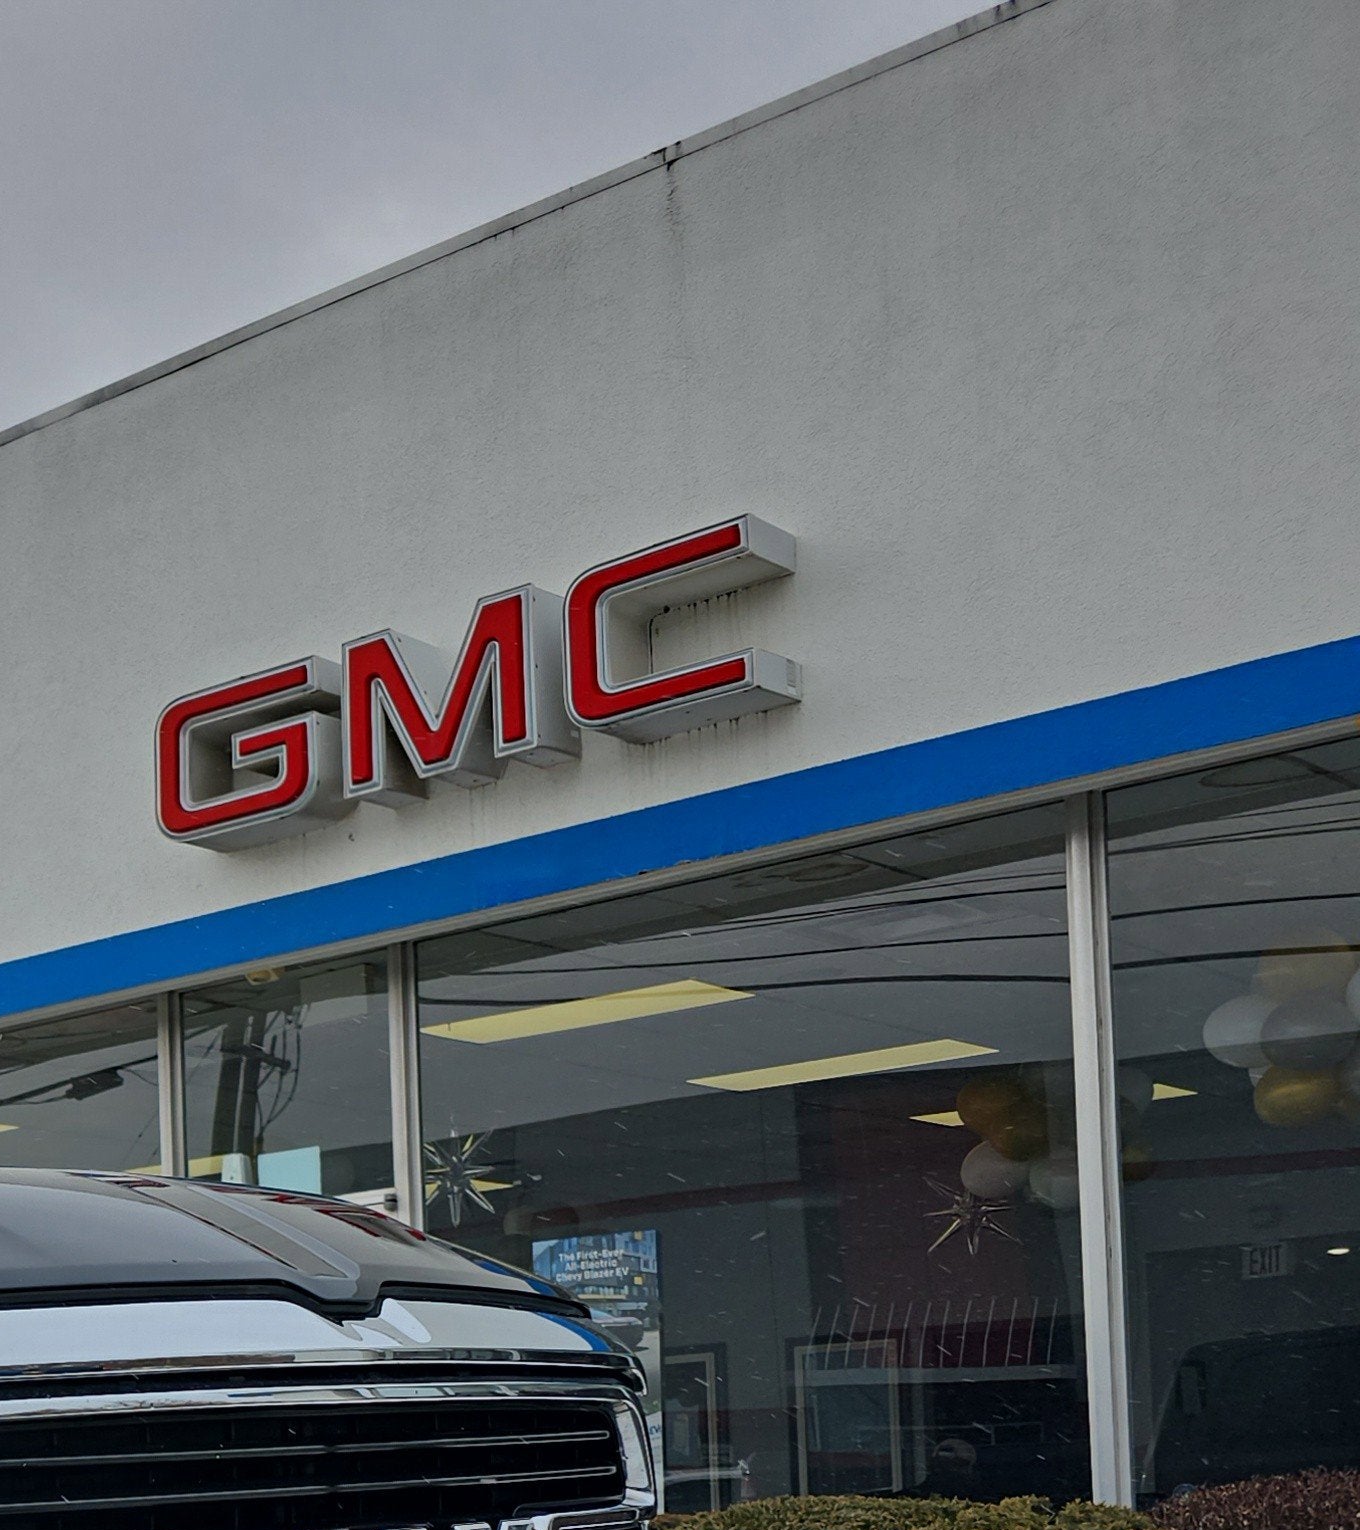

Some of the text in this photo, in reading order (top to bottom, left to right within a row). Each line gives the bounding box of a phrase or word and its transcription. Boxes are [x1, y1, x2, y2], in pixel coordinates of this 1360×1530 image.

[155, 512, 802, 850] GMC
[559, 1252, 576, 1262] The
[1250, 1245, 1281, 1275] EXIT
[584, 1269, 614, 1280] Blazer
[616, 1267, 630, 1277] EV
